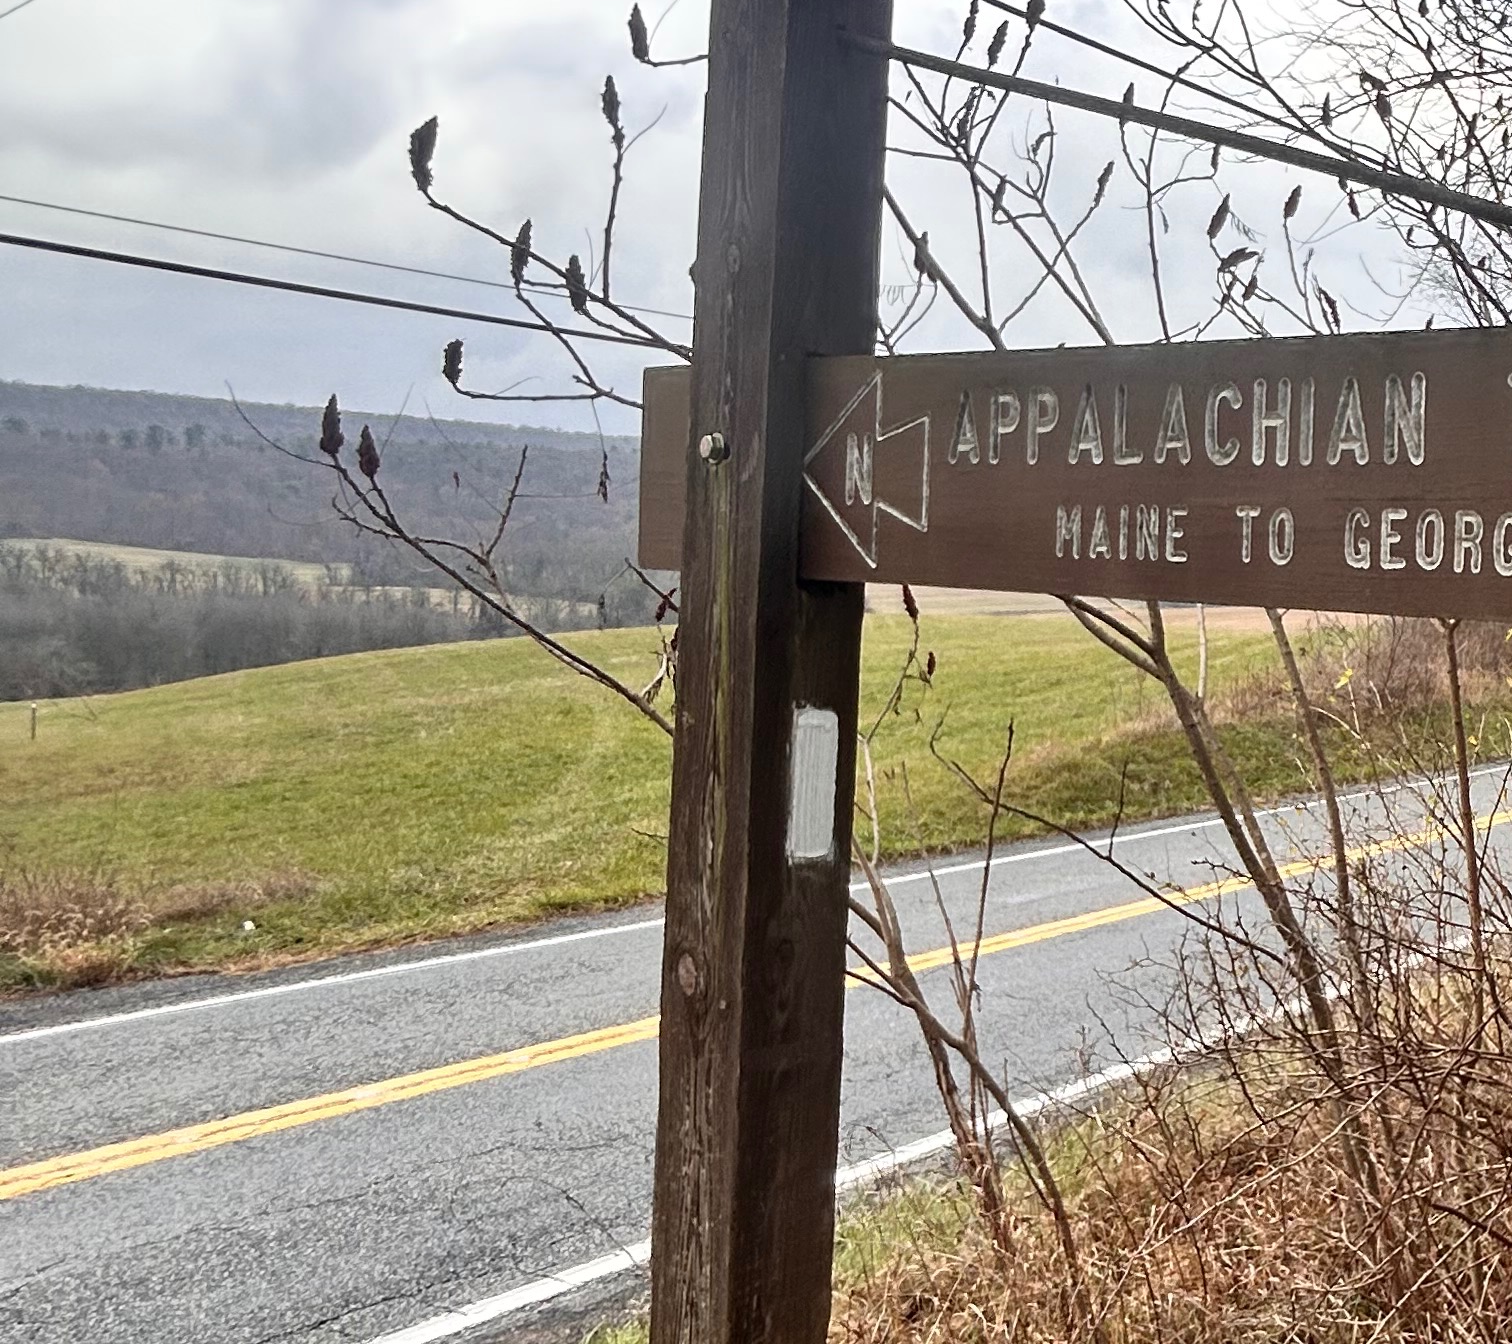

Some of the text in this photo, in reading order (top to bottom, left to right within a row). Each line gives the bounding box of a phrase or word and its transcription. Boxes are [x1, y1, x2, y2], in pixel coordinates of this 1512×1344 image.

[948, 372, 1427, 467] APPALACHIAN
[845, 432, 874, 506] N
[1055, 503, 1190, 563] MAINE
[1236, 505, 1295, 566] TO
